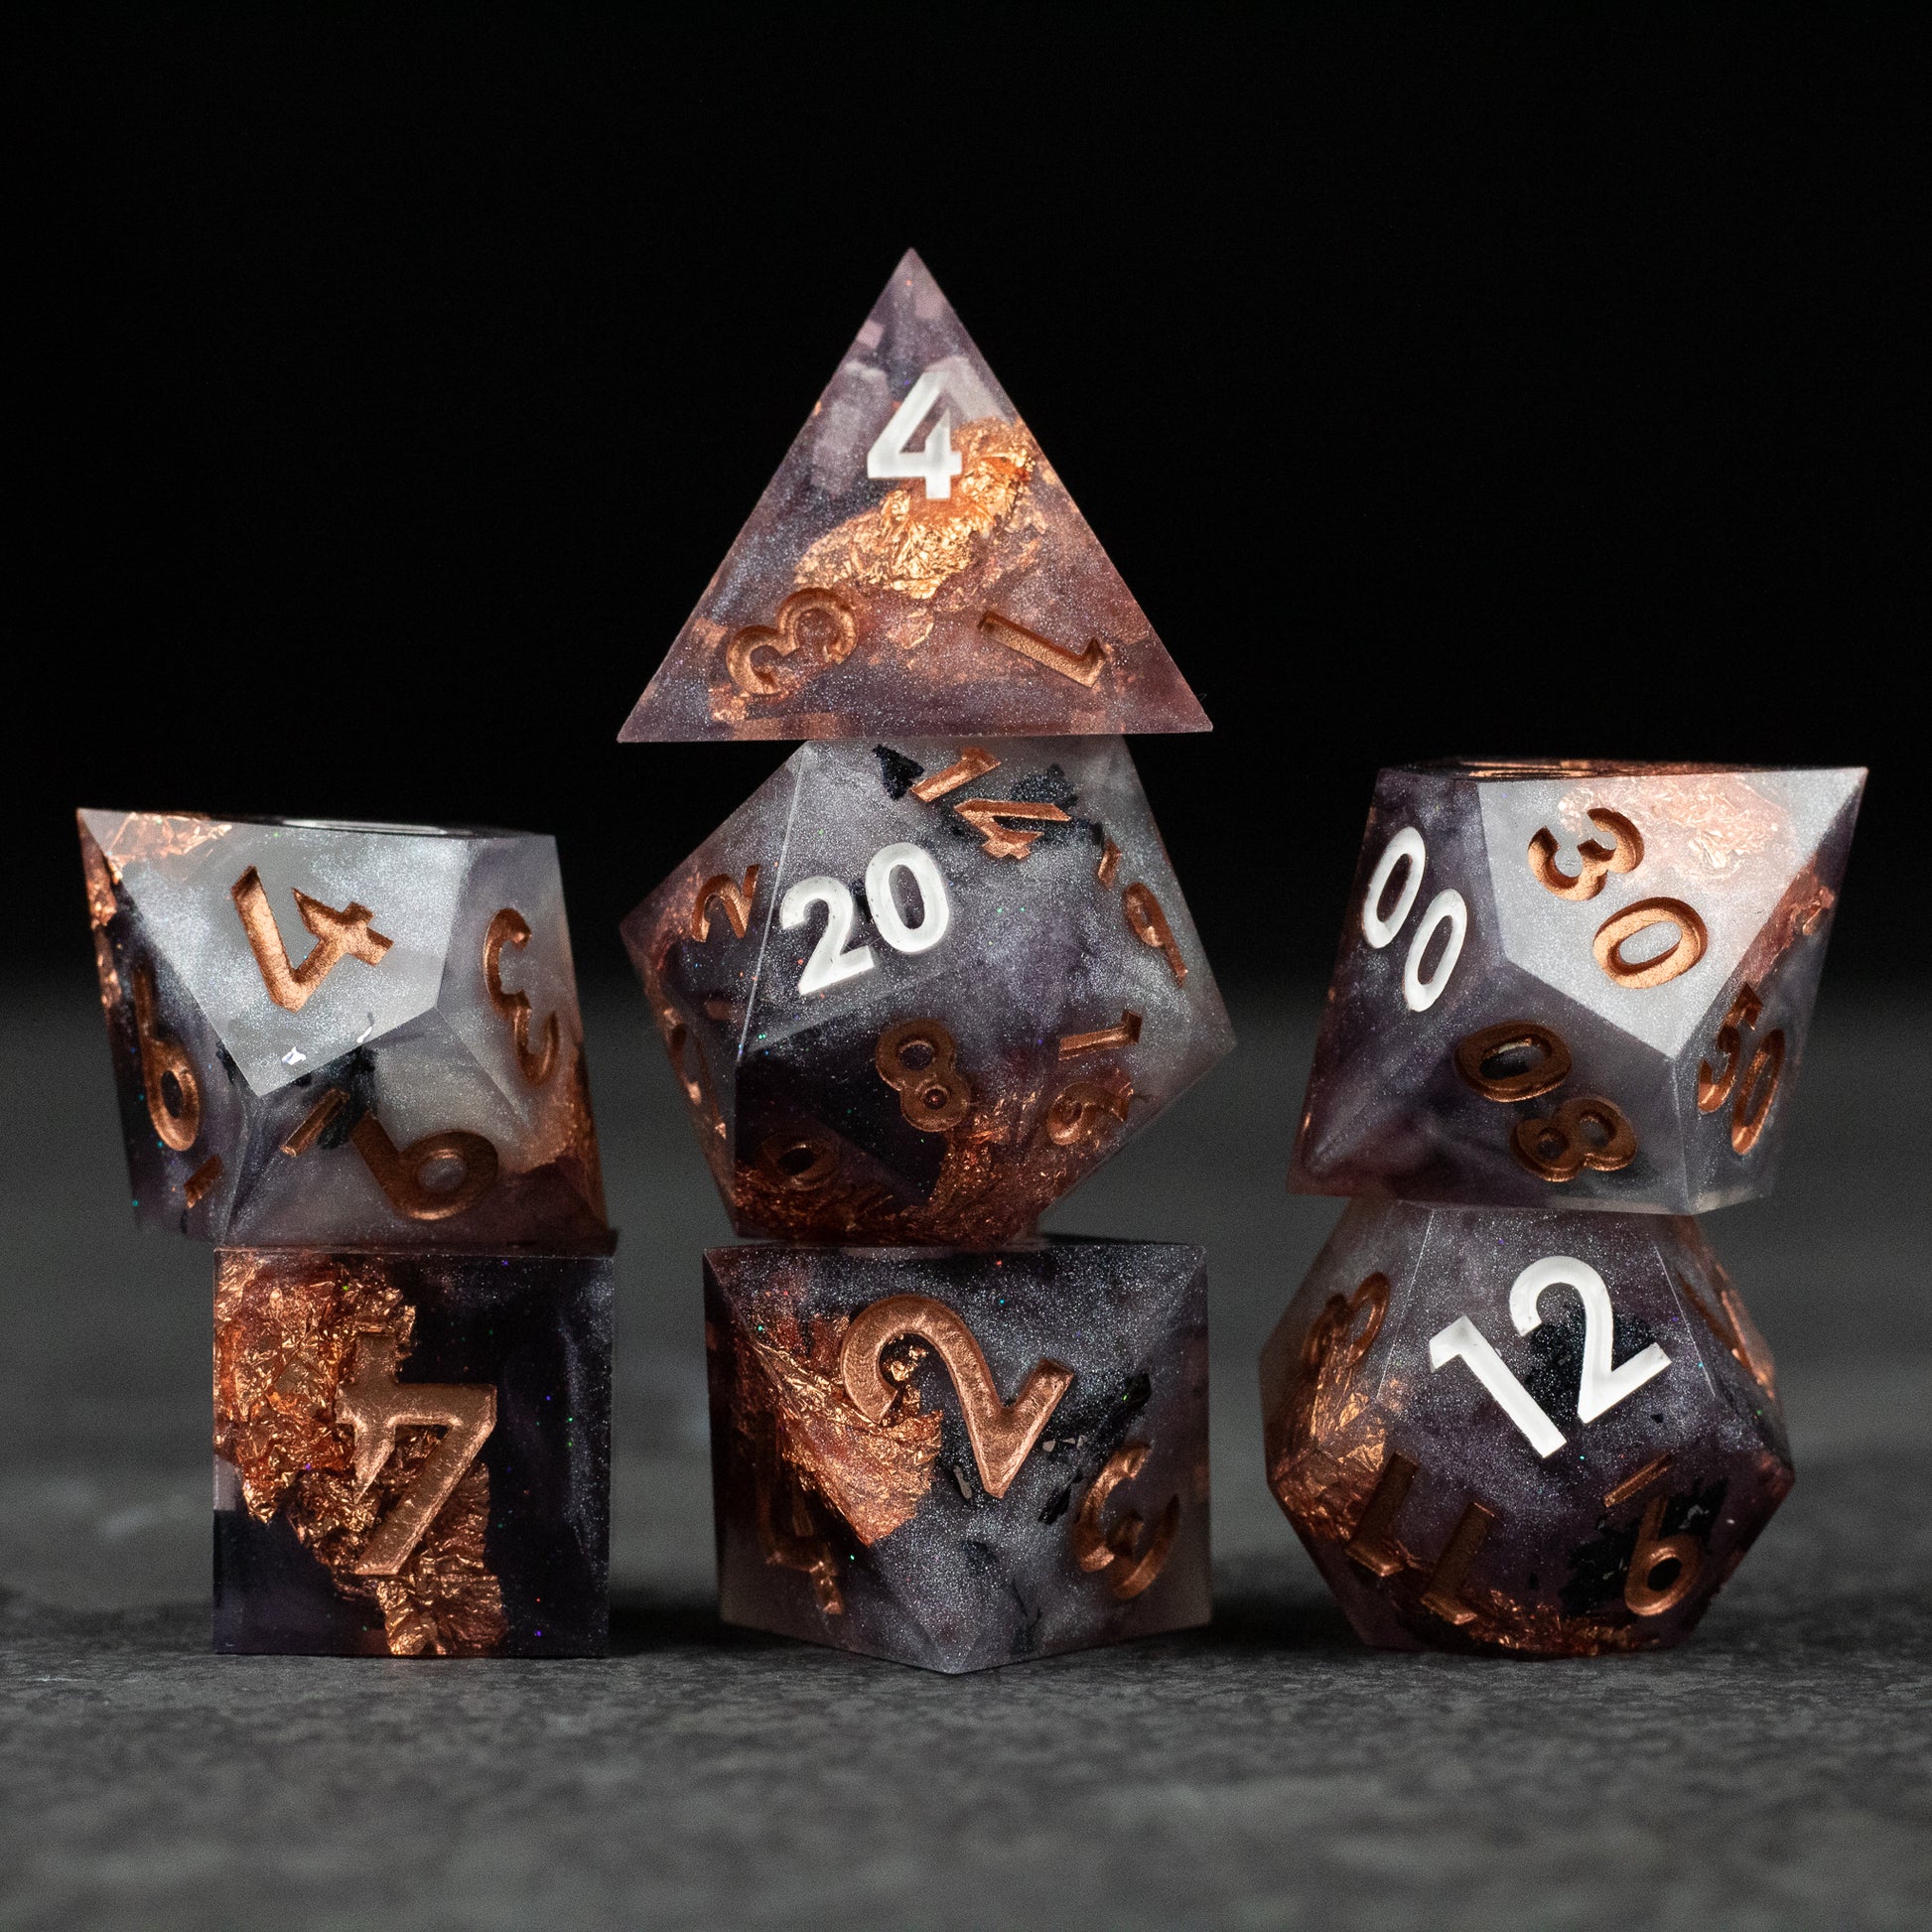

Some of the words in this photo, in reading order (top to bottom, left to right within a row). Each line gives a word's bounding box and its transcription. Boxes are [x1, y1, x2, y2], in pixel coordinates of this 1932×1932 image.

[867, 367, 962, 500] 4
[726, 588, 857, 695] 3
[977, 610, 1106, 688] 1
[911, 747, 1072, 860] 14
[231, 866, 393, 1014] 4
[693, 865, 759, 943] 2
[779, 842, 950, 995] 20
[1361, 826, 1467, 1013] 00
[1527, 806, 1708, 990] 30
[483, 907, 560, 1084] 3
[1698, 983, 1785, 1156] 50
[875, 1018, 972, 1133] 8
[840, 1295, 1074, 1499] 2
[1428, 1255, 1673, 1459] 12
[336, 1332, 497, 1576] 4
